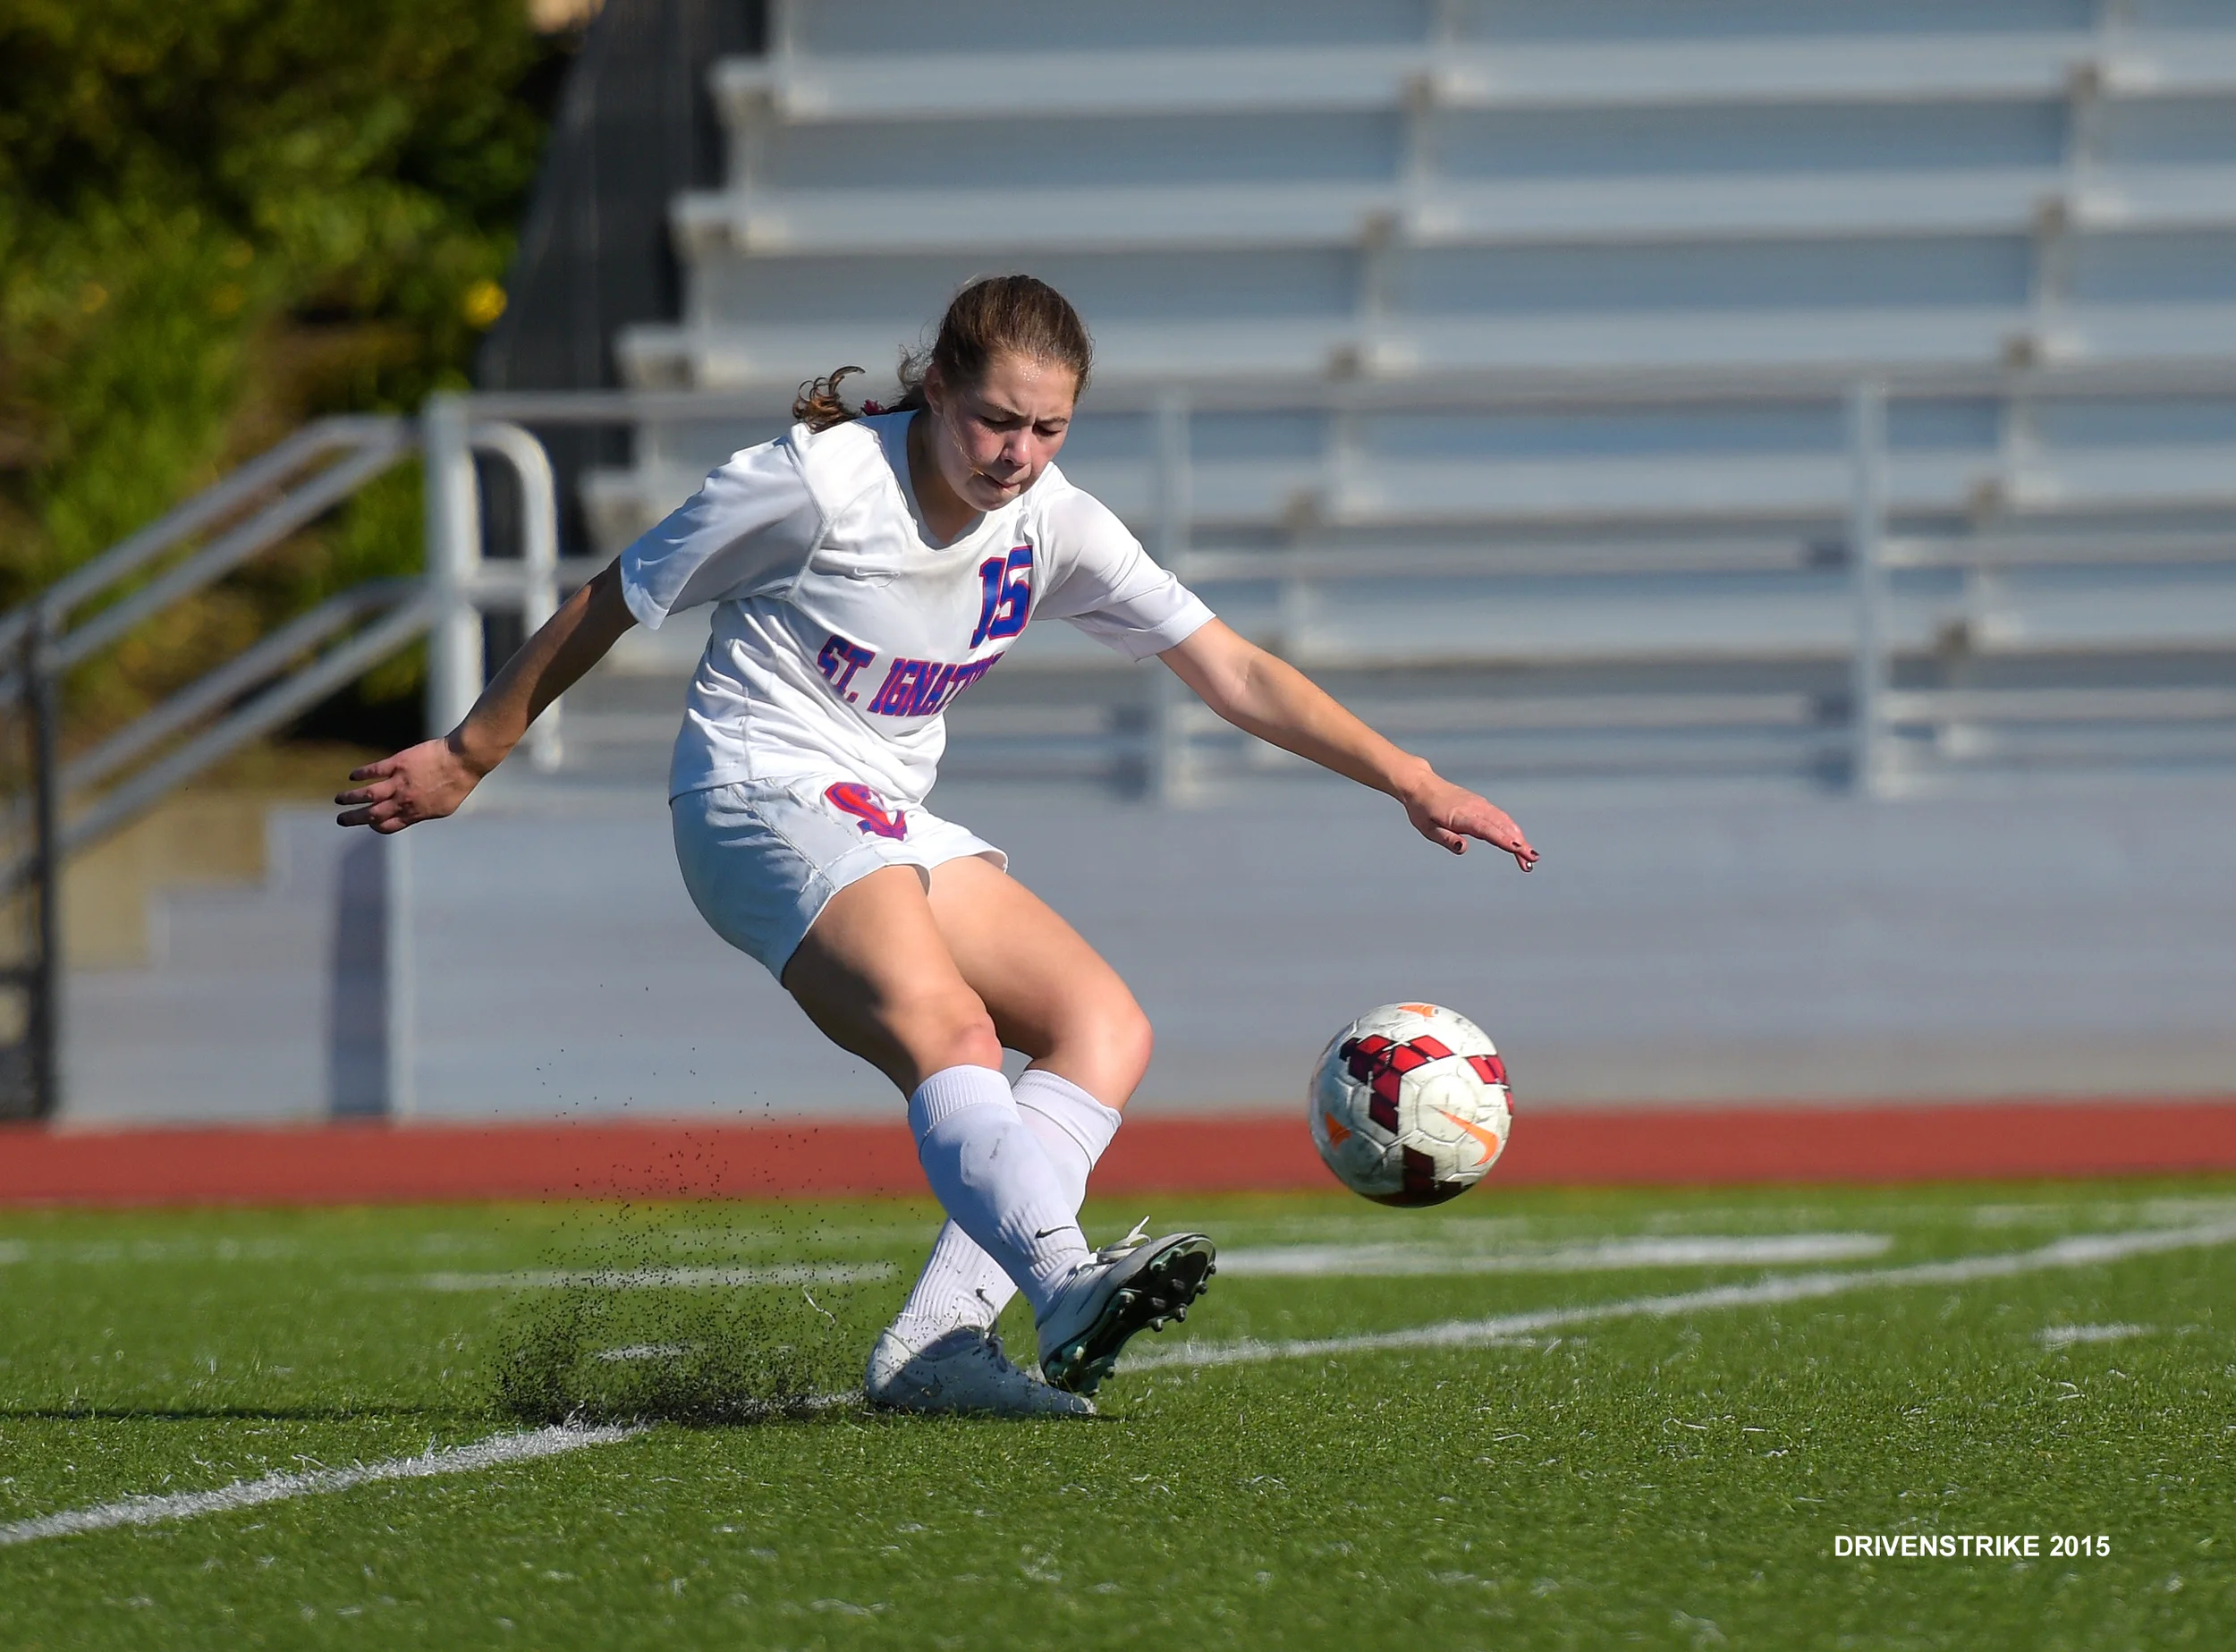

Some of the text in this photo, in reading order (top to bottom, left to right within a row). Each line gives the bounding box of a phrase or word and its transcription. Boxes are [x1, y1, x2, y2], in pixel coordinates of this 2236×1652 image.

[970, 545, 1033, 649] 15
[817, 635, 1005, 716] ST. IGNAT
